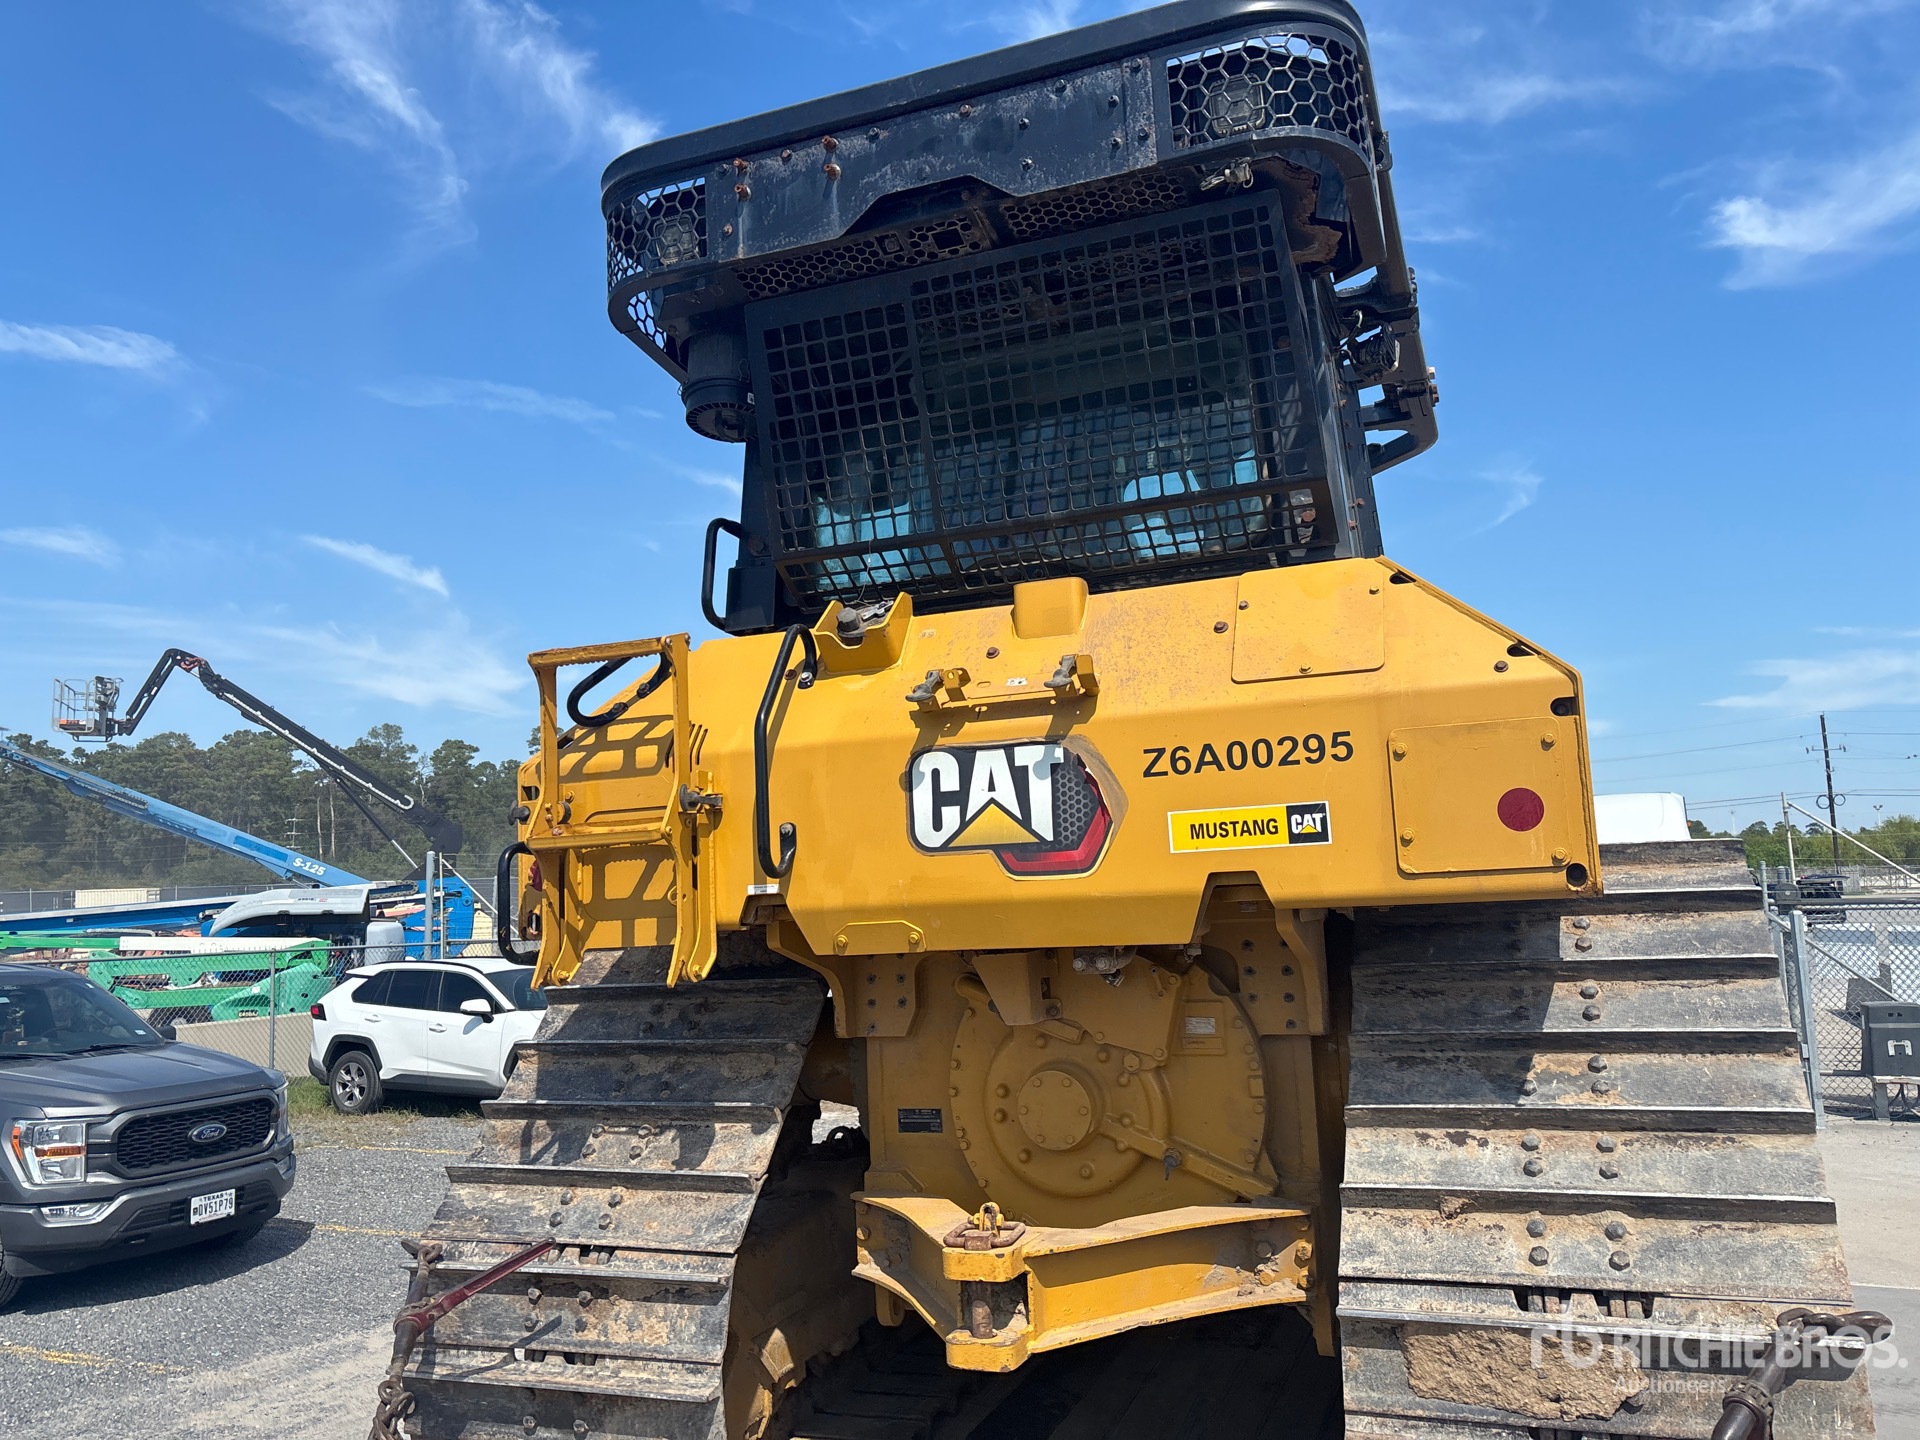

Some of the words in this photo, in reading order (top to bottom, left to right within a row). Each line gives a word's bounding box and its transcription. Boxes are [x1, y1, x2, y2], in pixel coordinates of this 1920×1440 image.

[1143, 731, 1354, 778] Z6A00295
[912, 744, 1064, 848] CAT
[1190, 818, 1279, 840] MUSTANG
[1290, 812, 1325, 835] CAT
[292, 857, 326, 876] S-125
[203, 1192, 223, 1202] TEXAS
